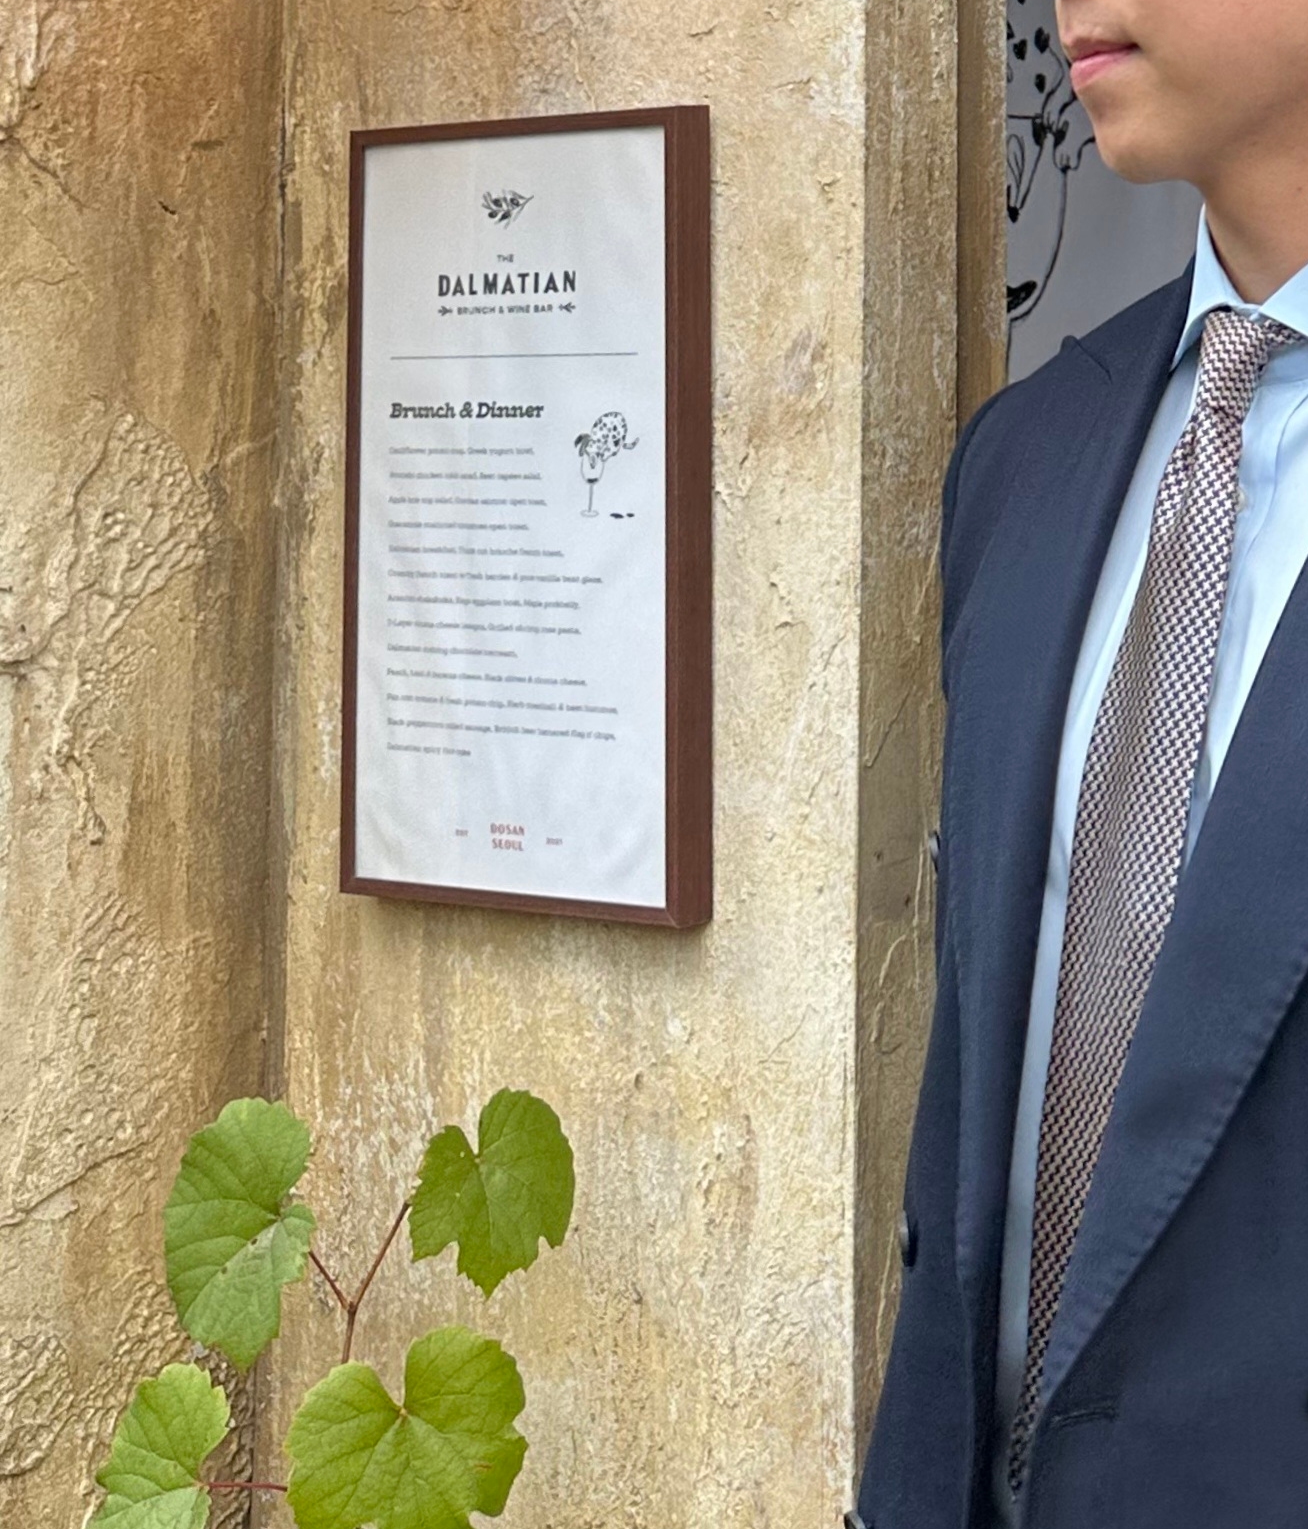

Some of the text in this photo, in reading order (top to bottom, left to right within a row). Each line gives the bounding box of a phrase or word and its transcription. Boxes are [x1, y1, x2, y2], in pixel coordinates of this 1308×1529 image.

[496, 254, 514, 263] THE
[438, 270, 577, 297] DALMATIAN
[457, 305, 496, 316] BRUNCH
[507, 304, 531, 314] WINE
[533, 304, 553, 314] BAR
[389, 401, 545, 419] Brunch & Dinner
[490, 822, 525, 836] DOSAN
[492, 837, 525, 851] SEOUL
